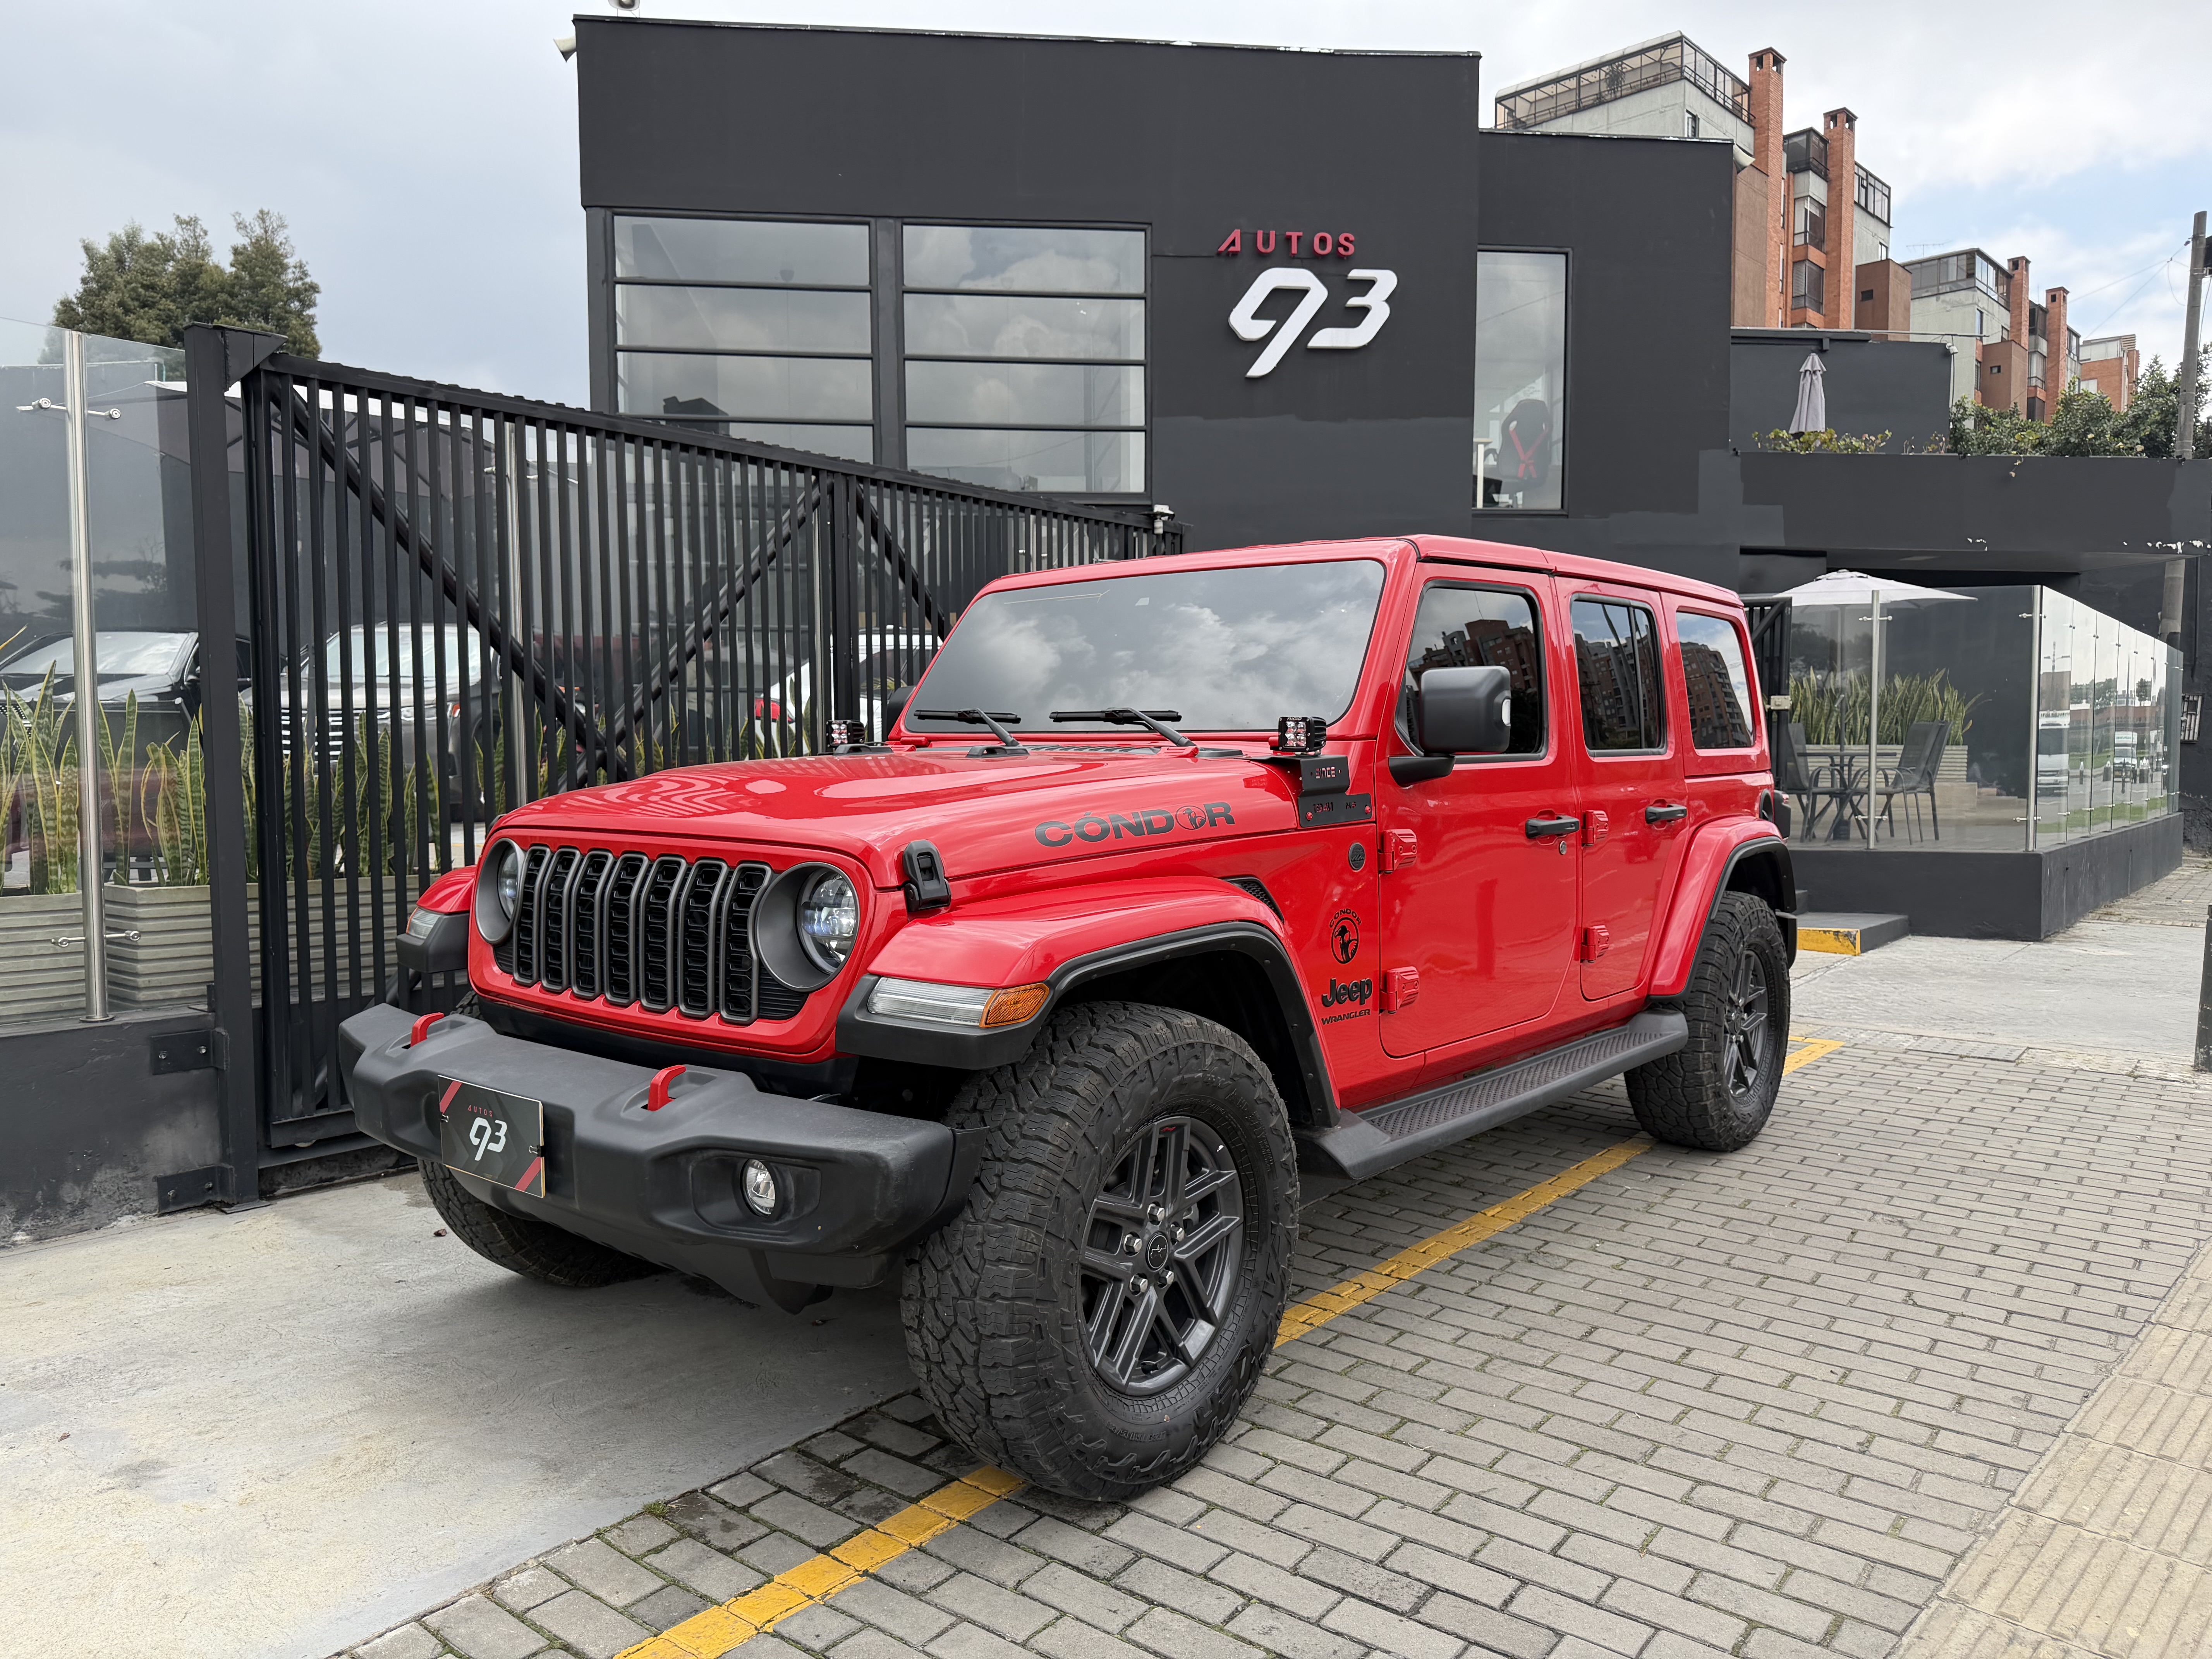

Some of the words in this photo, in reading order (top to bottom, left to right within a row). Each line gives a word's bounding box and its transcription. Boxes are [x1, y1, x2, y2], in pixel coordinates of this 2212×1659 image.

[1217, 229, 1355, 256] AUTOS
[1228, 267, 1398, 378] 93
[1316, 766, 1336, 779] SINCE
[1321, 977, 1372, 1007] Jeep
[1321, 1008, 1370, 1025] WRANGLER
[467, 1104, 493, 1118] AUTOS
[469, 1117, 508, 1161] 93
